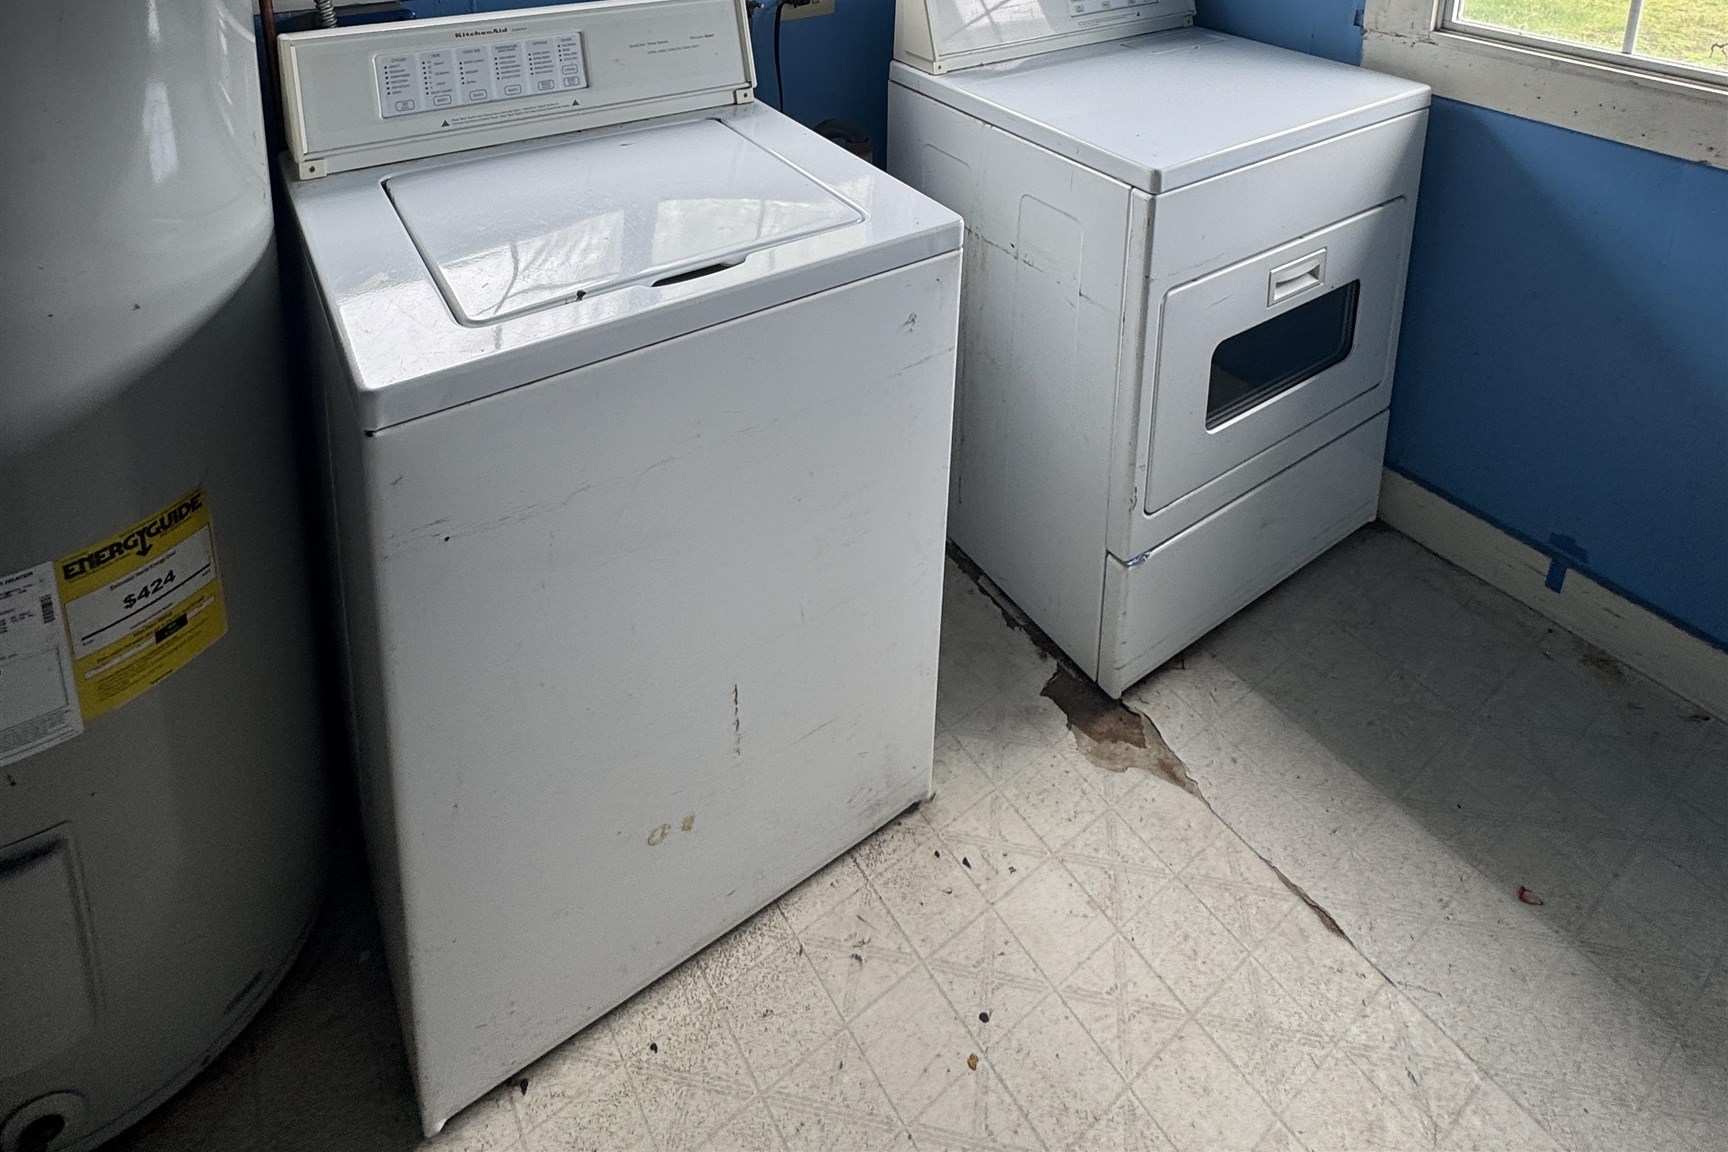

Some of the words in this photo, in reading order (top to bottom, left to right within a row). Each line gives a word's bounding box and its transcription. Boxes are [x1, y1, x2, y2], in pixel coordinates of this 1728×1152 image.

[455, 27, 508, 39] KitchenAid
[63, 492, 202, 581] ENERGYGUIDE
[123, 569, 176, 609] $424
